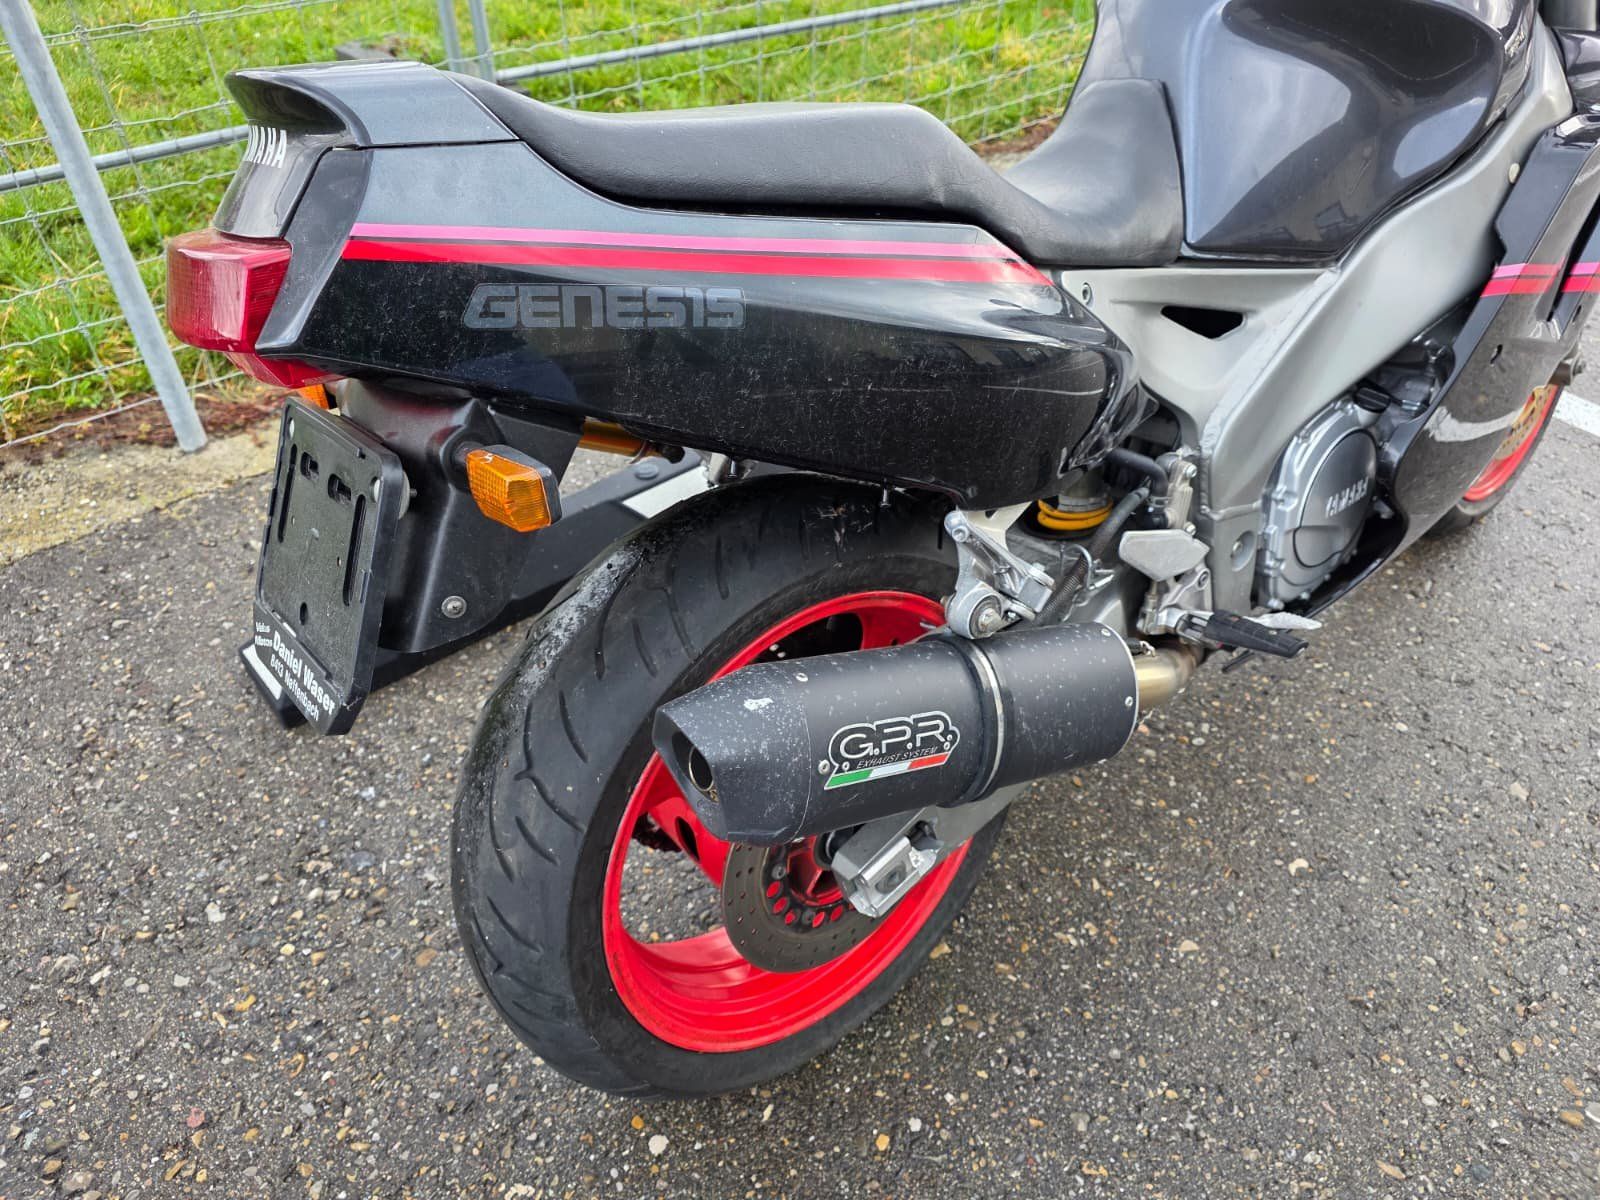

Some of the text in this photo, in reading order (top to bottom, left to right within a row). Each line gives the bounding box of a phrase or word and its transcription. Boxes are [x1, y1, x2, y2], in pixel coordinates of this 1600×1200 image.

[462, 283, 745, 328] GENESIS
[273, 630, 335, 715] Daniel Waser
[856, 746, 938, 769] EXHAUST SYSTEM
